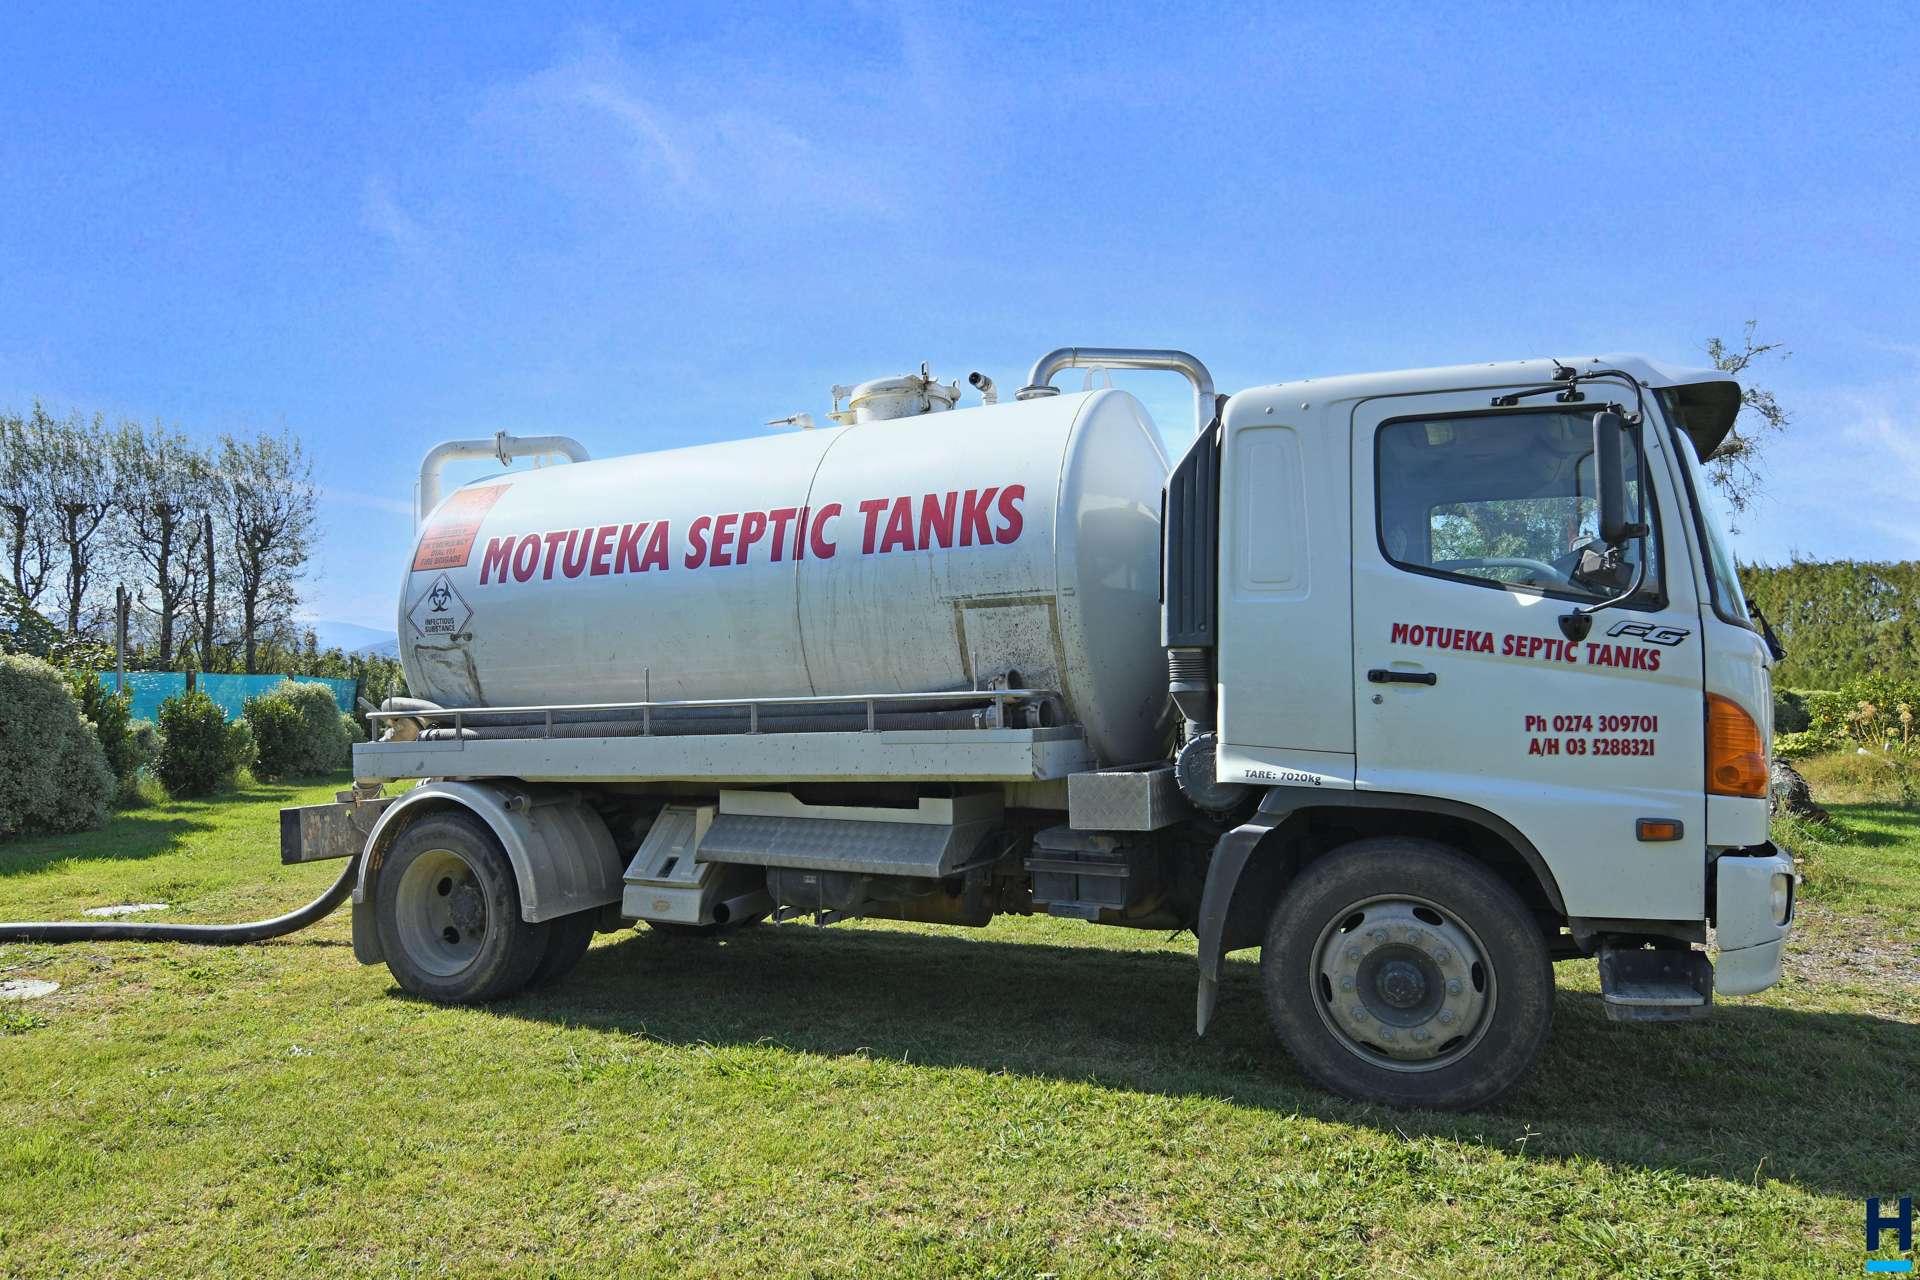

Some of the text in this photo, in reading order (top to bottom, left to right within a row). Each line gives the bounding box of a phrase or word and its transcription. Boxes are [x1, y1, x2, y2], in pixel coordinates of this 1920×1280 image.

[479, 484, 1026, 586] MOTUEKA SEPTIC TANKS
[1390, 622, 1661, 672] MOTUEKA SEPTIC TANKS
[1525, 715, 1658, 732] Ph 0274 309701
[1528, 738, 1654, 757] A/H 03 5288321
[1245, 769, 1322, 786] TARE: 7020kg
